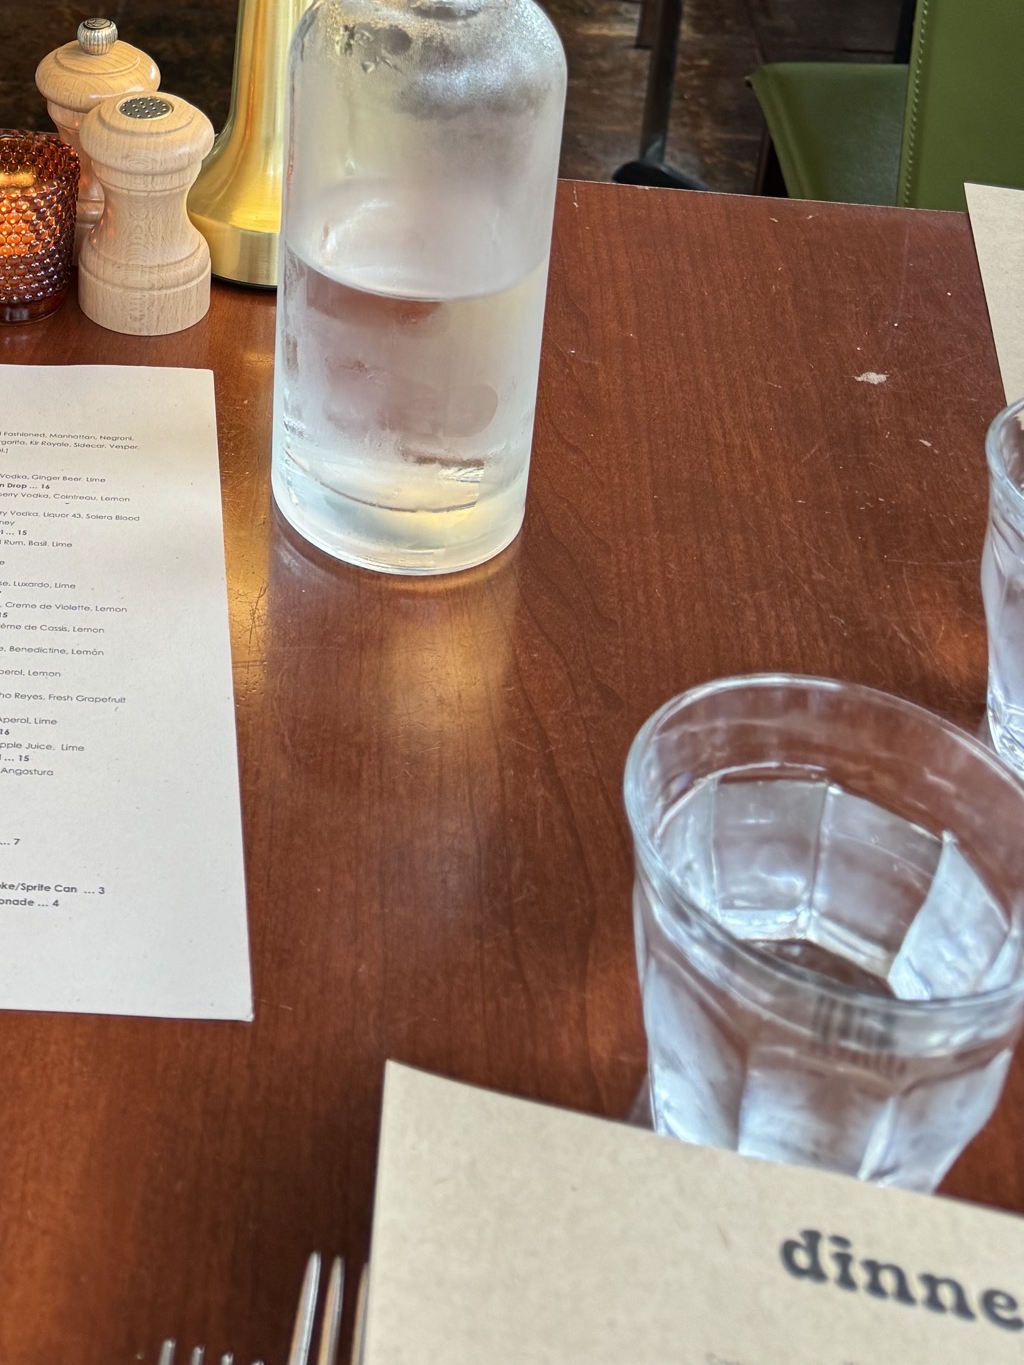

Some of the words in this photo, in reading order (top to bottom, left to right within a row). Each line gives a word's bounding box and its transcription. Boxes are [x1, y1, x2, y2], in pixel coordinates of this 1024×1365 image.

[13, 837, 20, 845] 7
[53, 884, 77, 892] Can
[98, 886, 104, 894] 3
